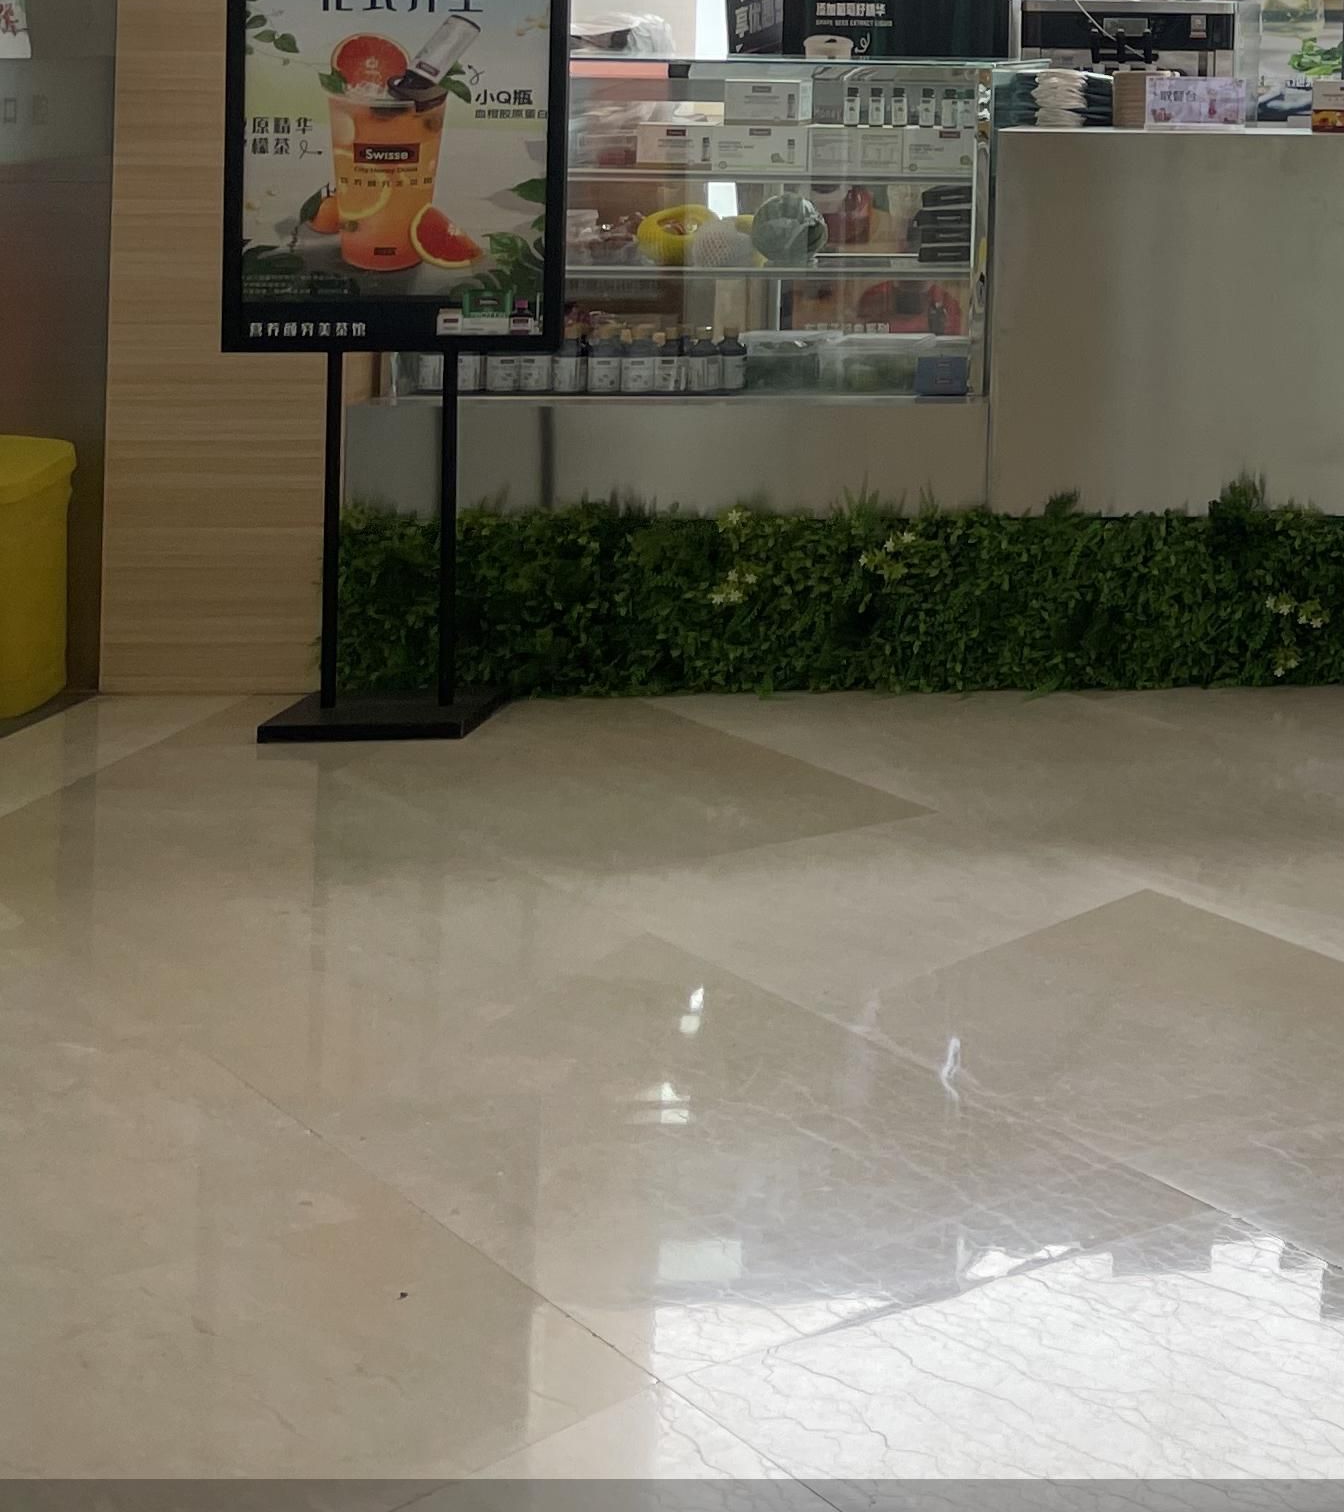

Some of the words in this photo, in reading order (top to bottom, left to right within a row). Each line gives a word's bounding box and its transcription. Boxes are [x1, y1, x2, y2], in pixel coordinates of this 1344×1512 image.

[475, 89, 534, 106] 小Q瓶
[244, 116, 314, 136] 原精华
[244, 136, 291, 157] 檬茶
